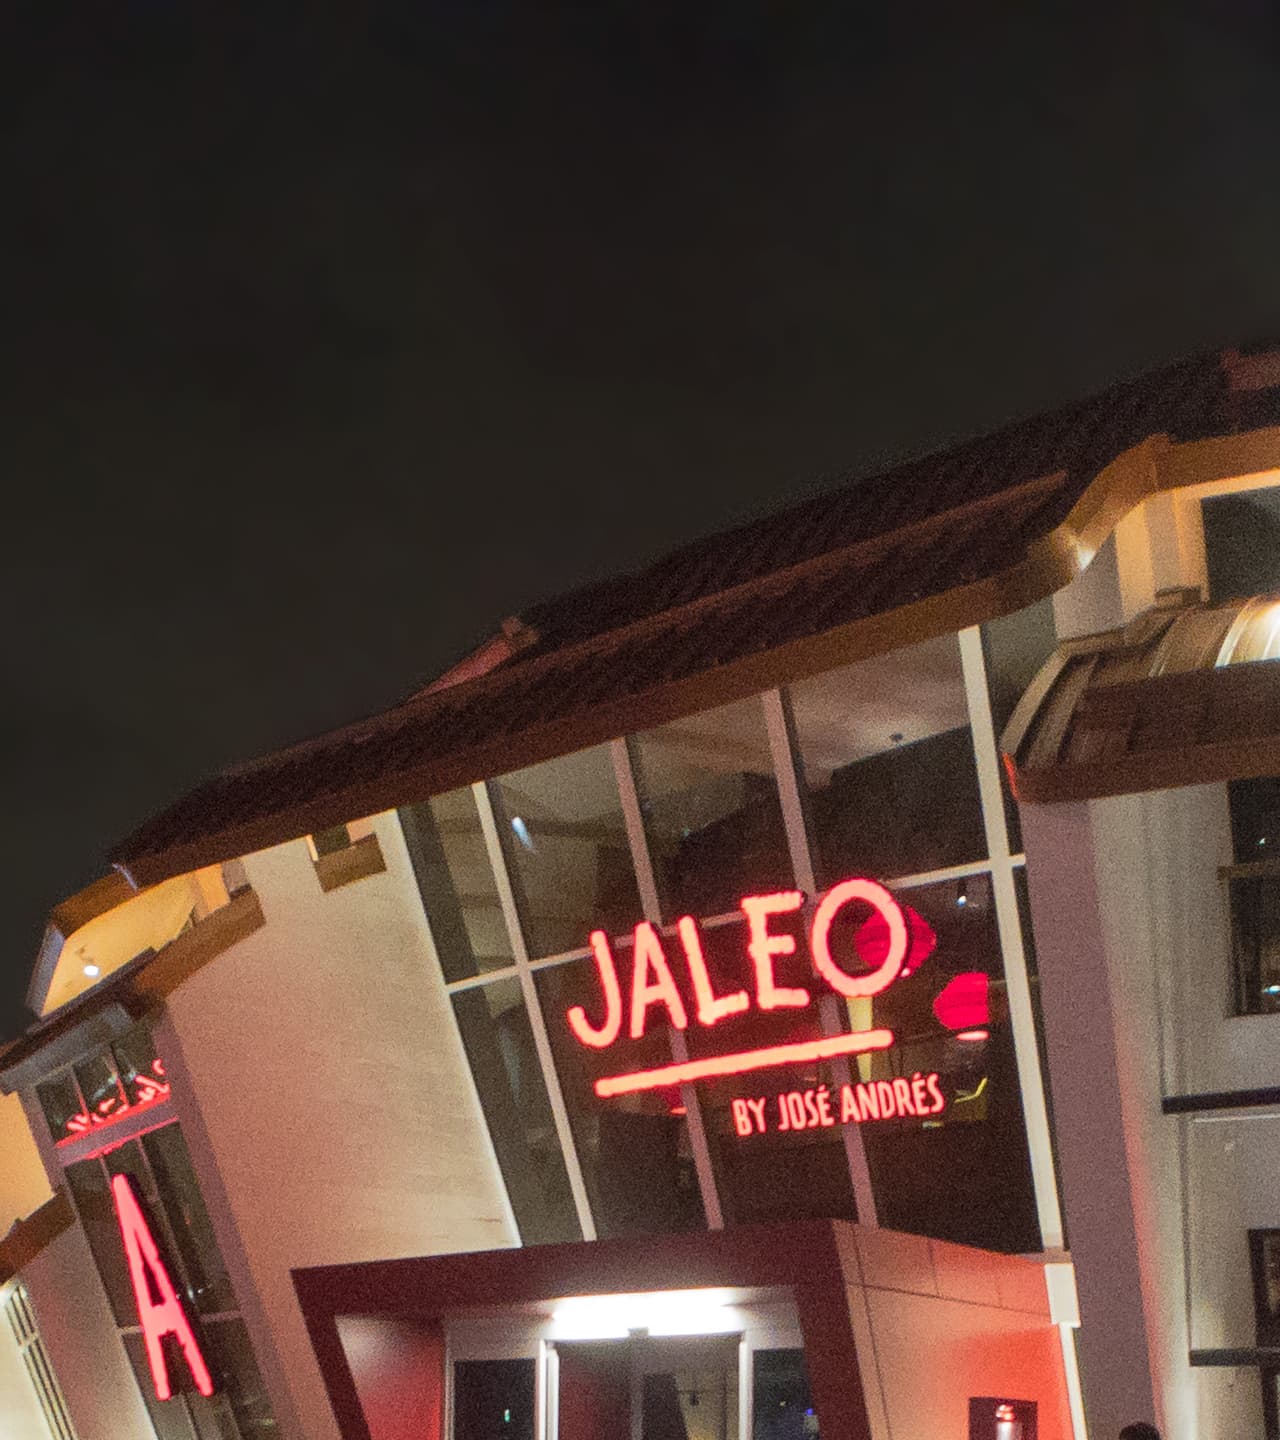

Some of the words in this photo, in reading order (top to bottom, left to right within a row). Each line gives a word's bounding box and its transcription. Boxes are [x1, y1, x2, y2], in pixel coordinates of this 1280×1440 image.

[567, 877, 910, 1049] JALEO
[731, 1096, 767, 1137] BY
[777, 1084, 835, 1132] JOSÉ
[839, 1071, 945, 1125] ANDRÉS
[110, 1173, 214, 1401] A
